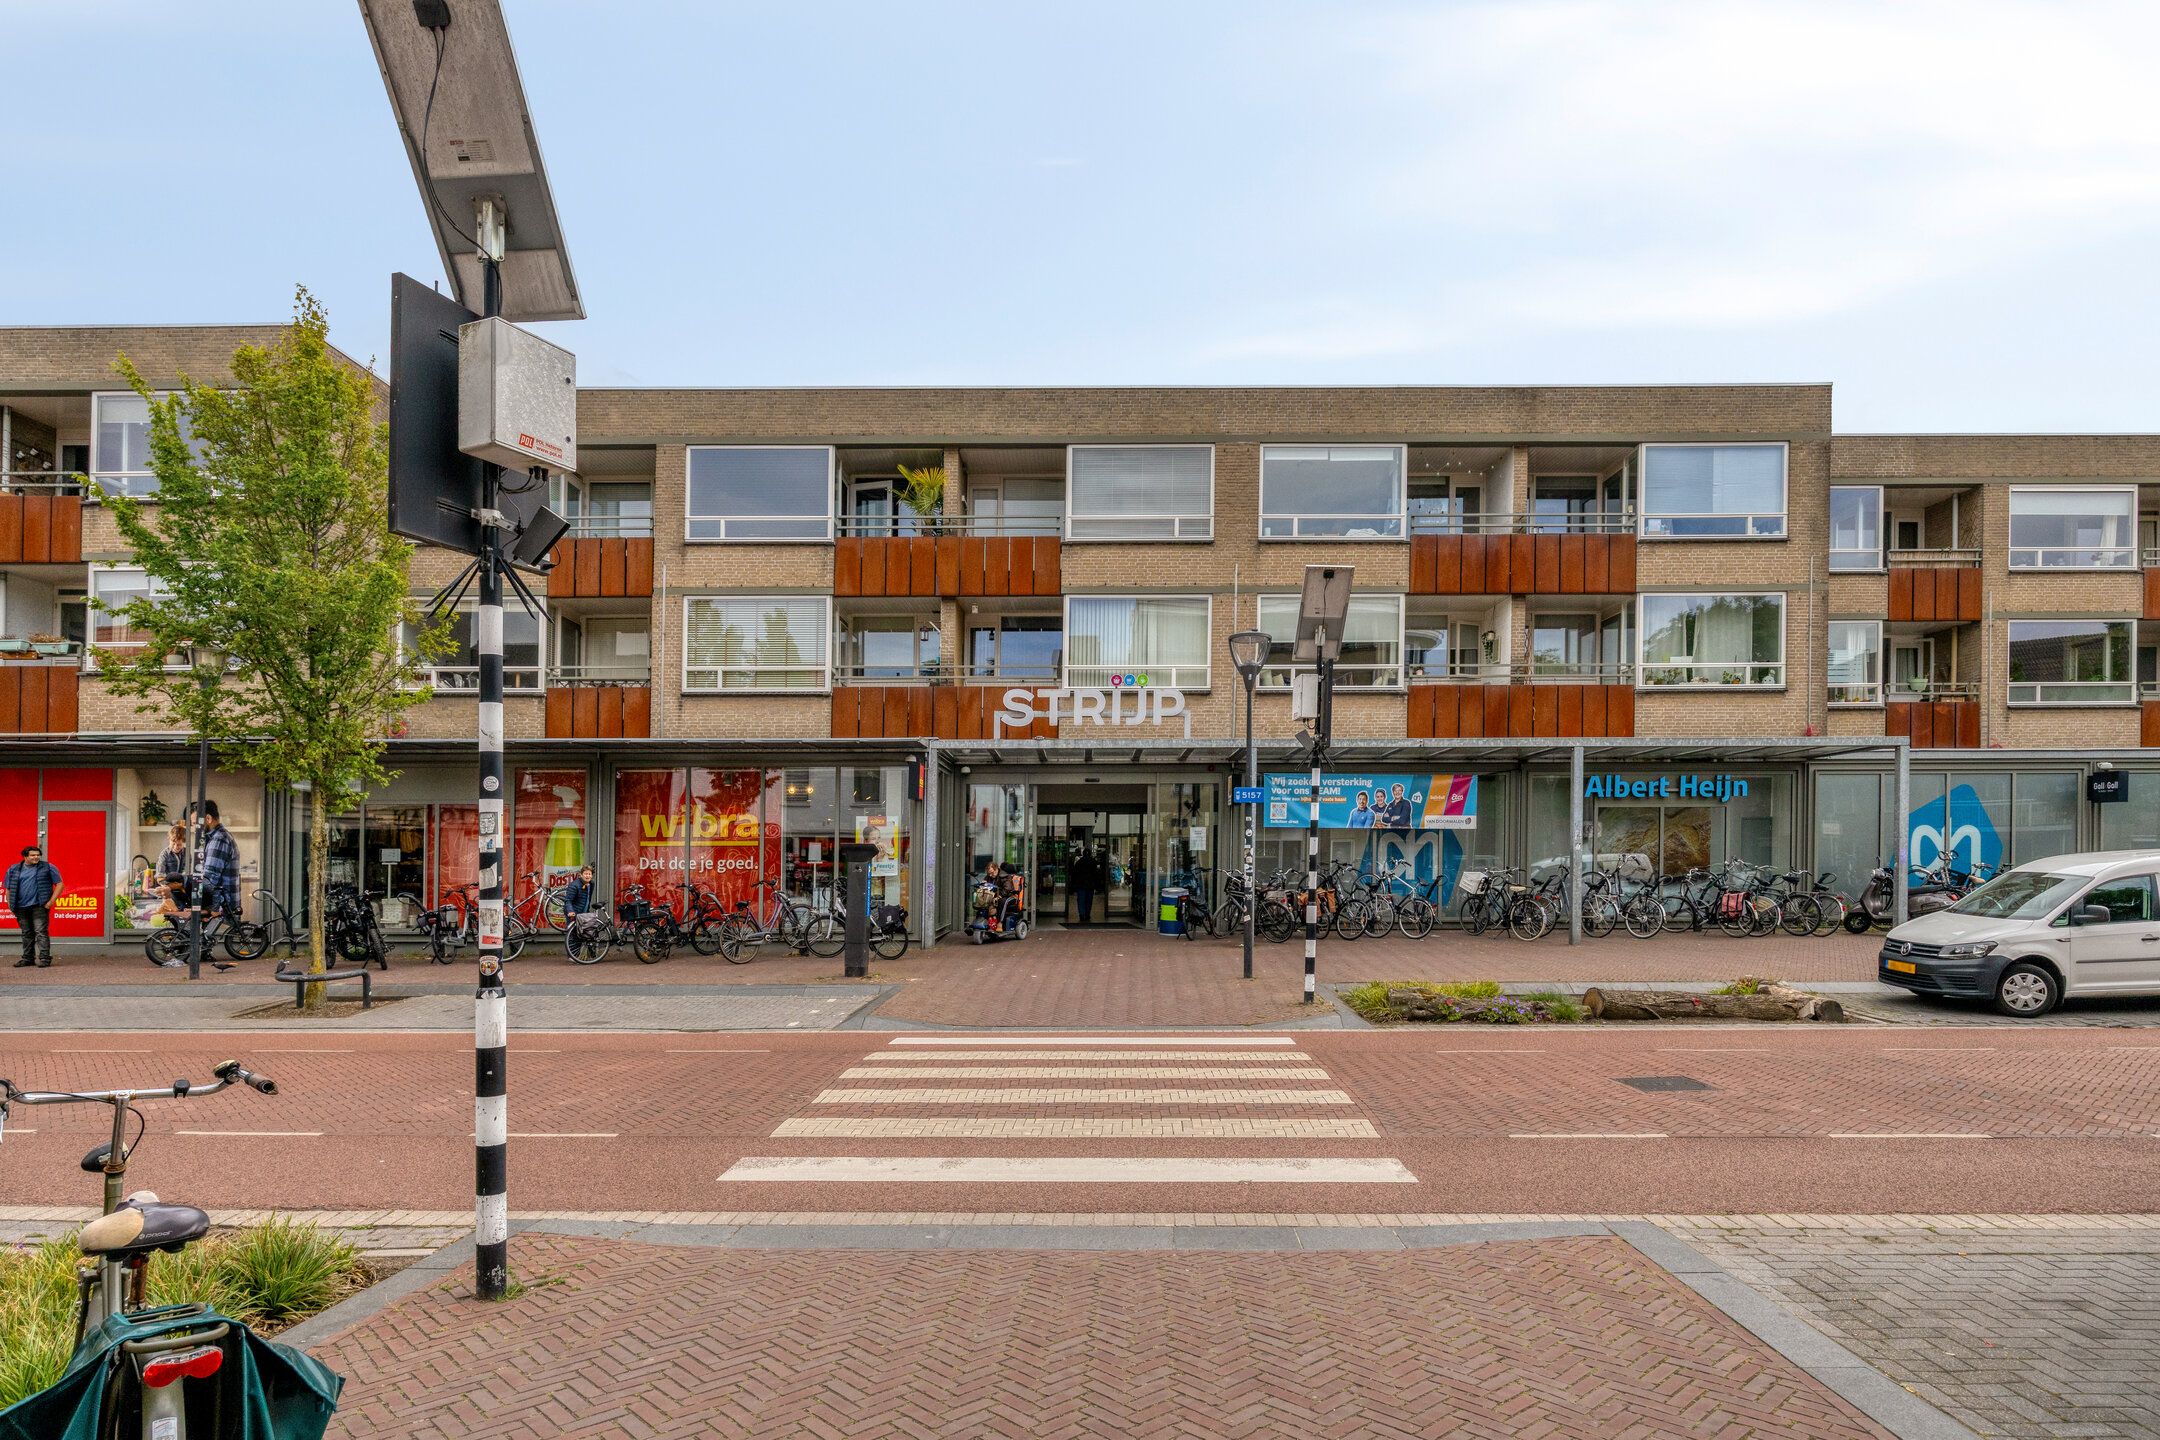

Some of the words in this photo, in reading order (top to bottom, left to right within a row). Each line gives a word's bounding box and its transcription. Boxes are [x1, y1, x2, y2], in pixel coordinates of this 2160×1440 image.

[520, 435, 533, 448] POL
[1000, 688, 1186, 727] STRIJP
[1271, 777, 1286, 787] Wij
[1287, 777, 1313, 786] zoeke
[1322, 778, 1373, 788] versterking
[1584, 774, 1670, 798] Albert
[1679, 774, 1749, 803] Heijn
[2106, 781, 2119, 789] Gall
[1241, 791, 1262, 799] 5157
[1271, 787, 1292, 795] voor
[1293, 787, 1310, 795] ons
[1318, 787, 1341, 795] EAM!
[640, 803, 760, 838] wibra
[639, 857, 665, 870] Dat
[699, 856, 714, 873] je
[716, 856, 759, 873] goed.
[55, 893, 97, 907] wibra
[76, 912, 82, 920] je
[82, 912, 97, 920] goed
